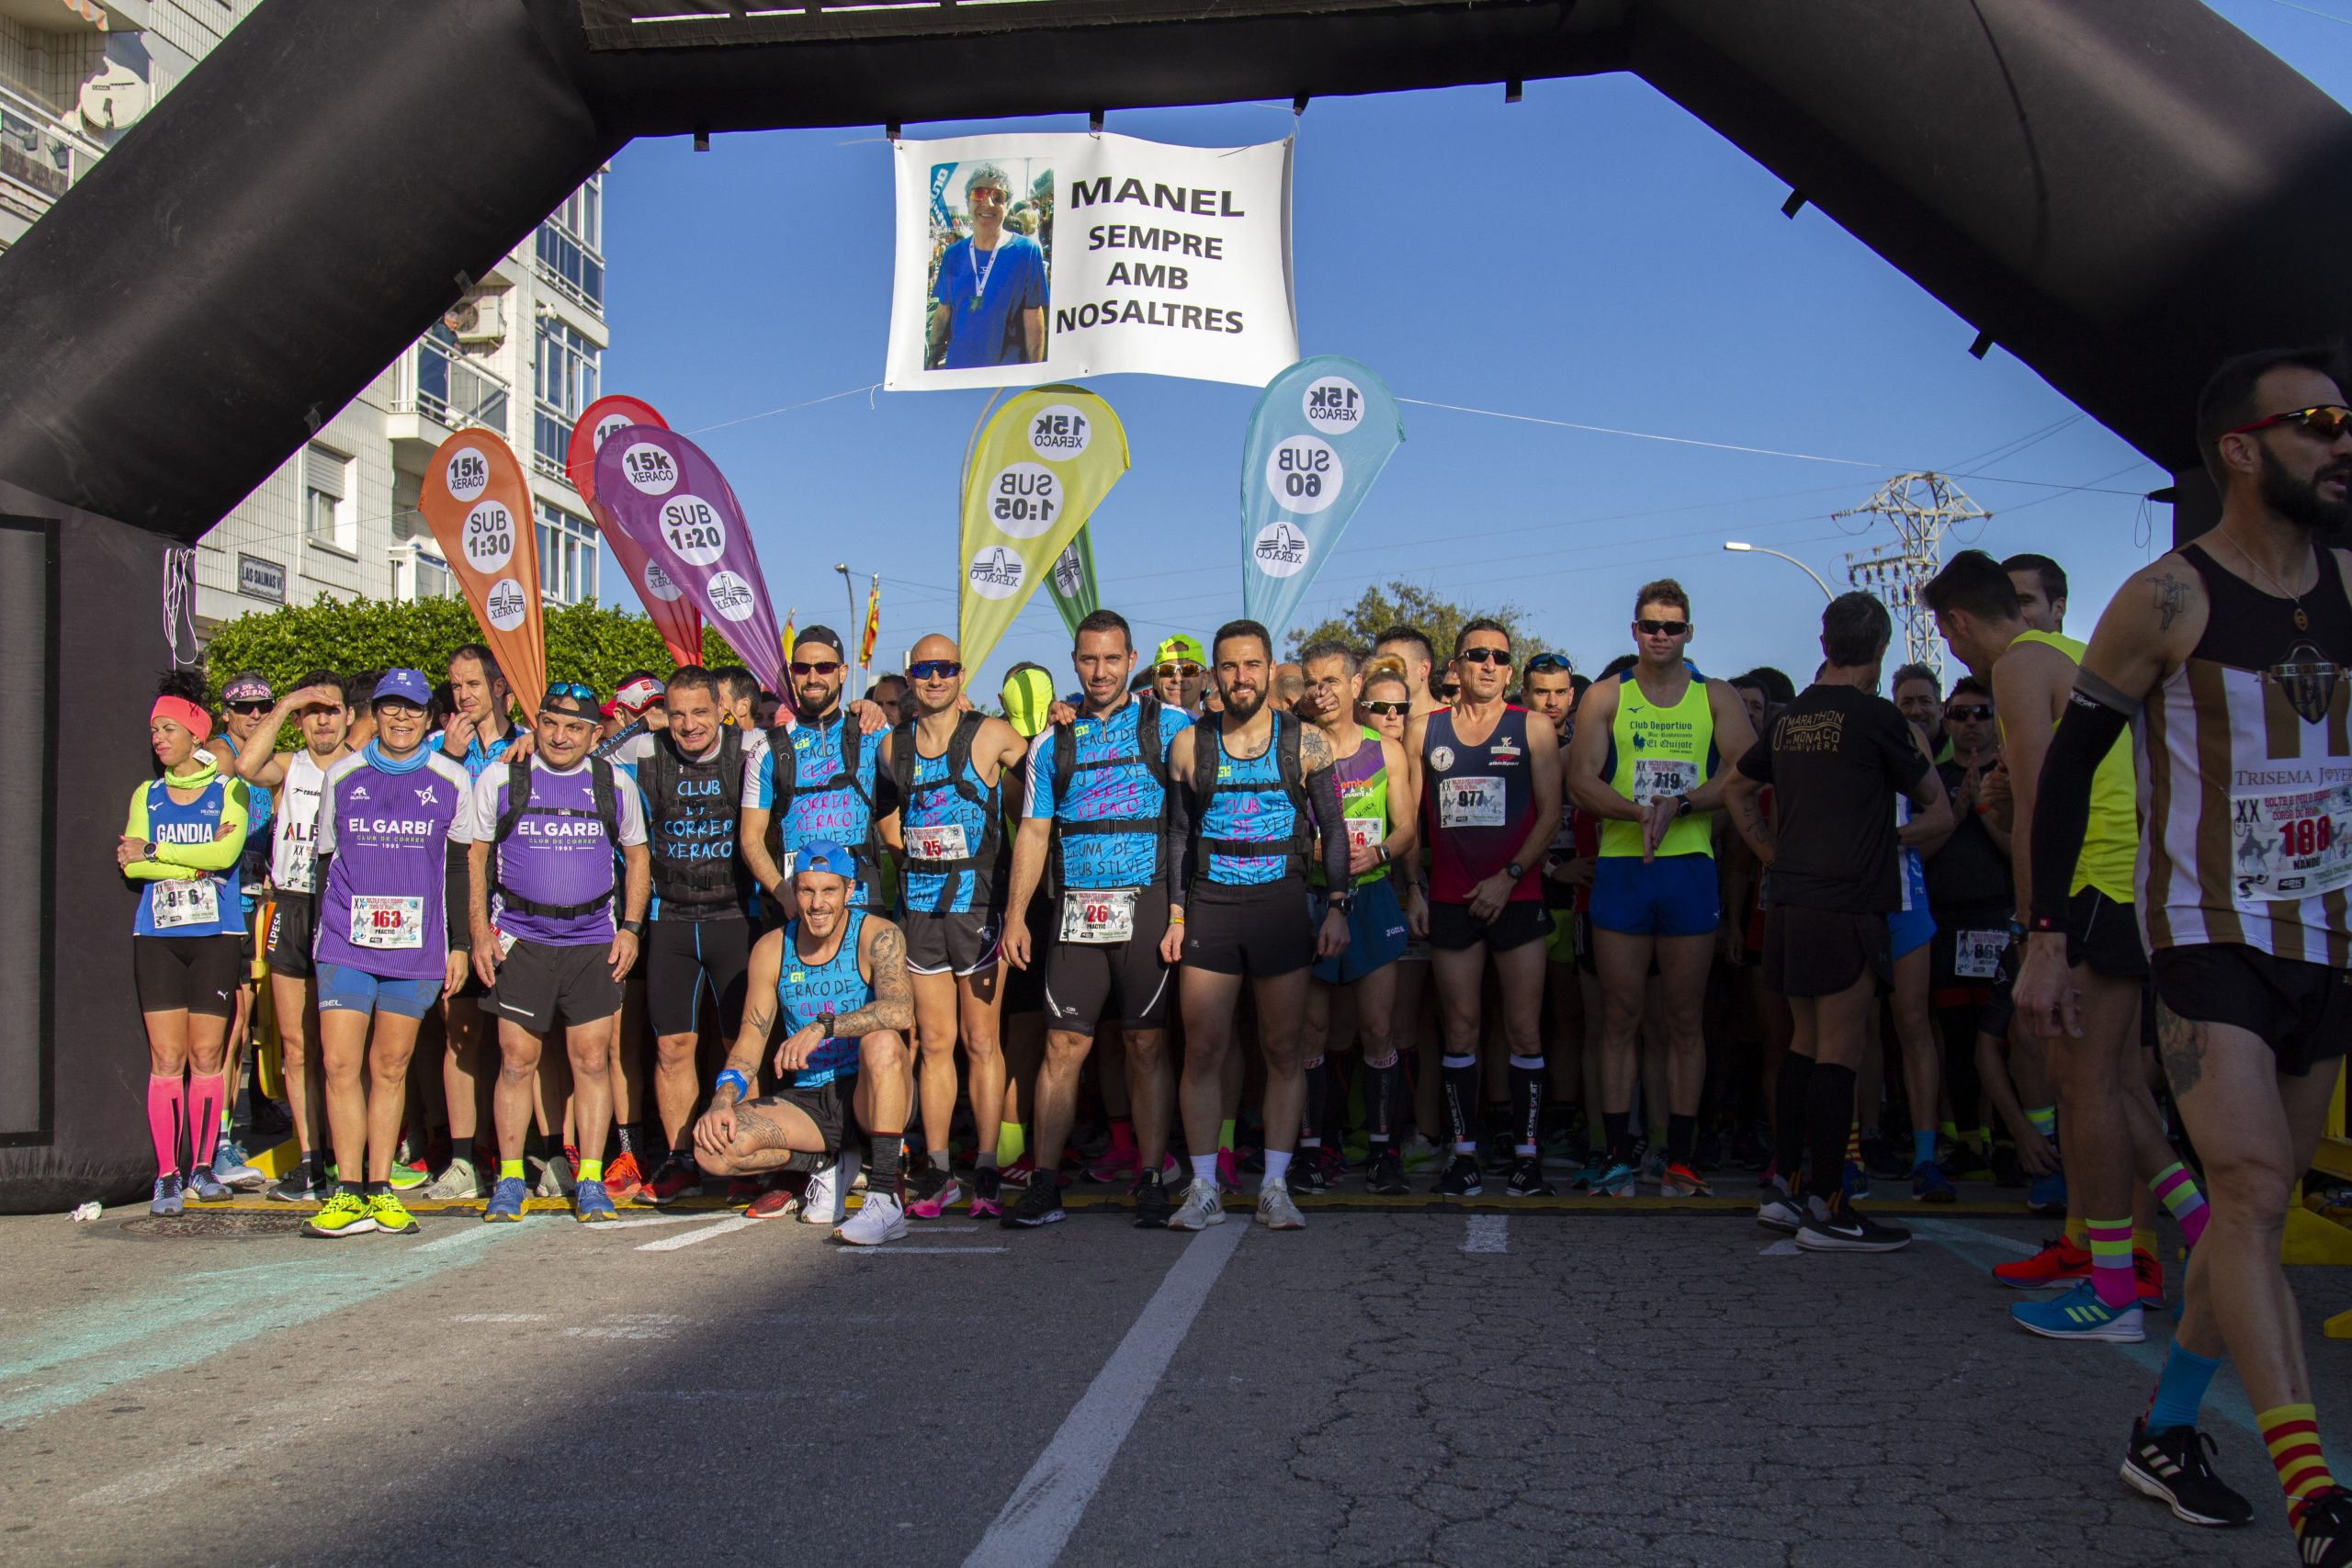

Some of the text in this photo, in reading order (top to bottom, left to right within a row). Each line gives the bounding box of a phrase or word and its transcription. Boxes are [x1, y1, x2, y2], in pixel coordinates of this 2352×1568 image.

[1071, 176, 1245, 218] MANEL
[1089, 225, 1223, 260] SEMPRE
[1106, 262, 1188, 290] AMB
[1056, 299, 1244, 334] NOSALTRES
[450, 457, 483, 479] 15k
[626, 452, 672, 471] 15k
[451, 476, 484, 491] XERACO
[631, 469, 673, 483] XERACO
[470, 508, 507, 533] SUB
[666, 505, 711, 527] SUB
[469, 533, 510, 558] 1:30
[670, 526, 720, 550] 1:20
[1630, 721, 1692, 731] Club Deportivo
[1788, 710, 1845, 728] MARATHON
[1079, 733, 1115, 750] RACO
[1793, 728, 1840, 744] MONACO
[1655, 772, 1679, 789] 719
[2234, 770, 2312, 786] TRISEMA
[677, 780, 720, 795] CLUB
[1225, 797, 1260, 815] CLUB
[1459, 791, 1484, 807] 977
[949, 808, 986, 824] XERA
[1076, 798, 1138, 819] XERACO
[2237, 799, 2260, 823] XX
[349, 818, 435, 836] EL GARBÍ
[518, 821, 541, 836] EL
[664, 818, 733, 839] CORRER
[795, 811, 853, 832] XERACO
[1233, 818, 1255, 834] DE
[156, 823, 213, 843] GANDIA
[2279, 815, 2331, 856] 188
[667, 840, 732, 862] XERACO
[923, 840, 942, 856] 25
[1113, 842, 1134, 857] DE
[1096, 857, 1155, 874] SILVES
[372, 910, 401, 928] 163
[1087, 905, 1108, 923] 26
[267, 912, 281, 952] ALPESA
[799, 999, 835, 1017] CLUB
